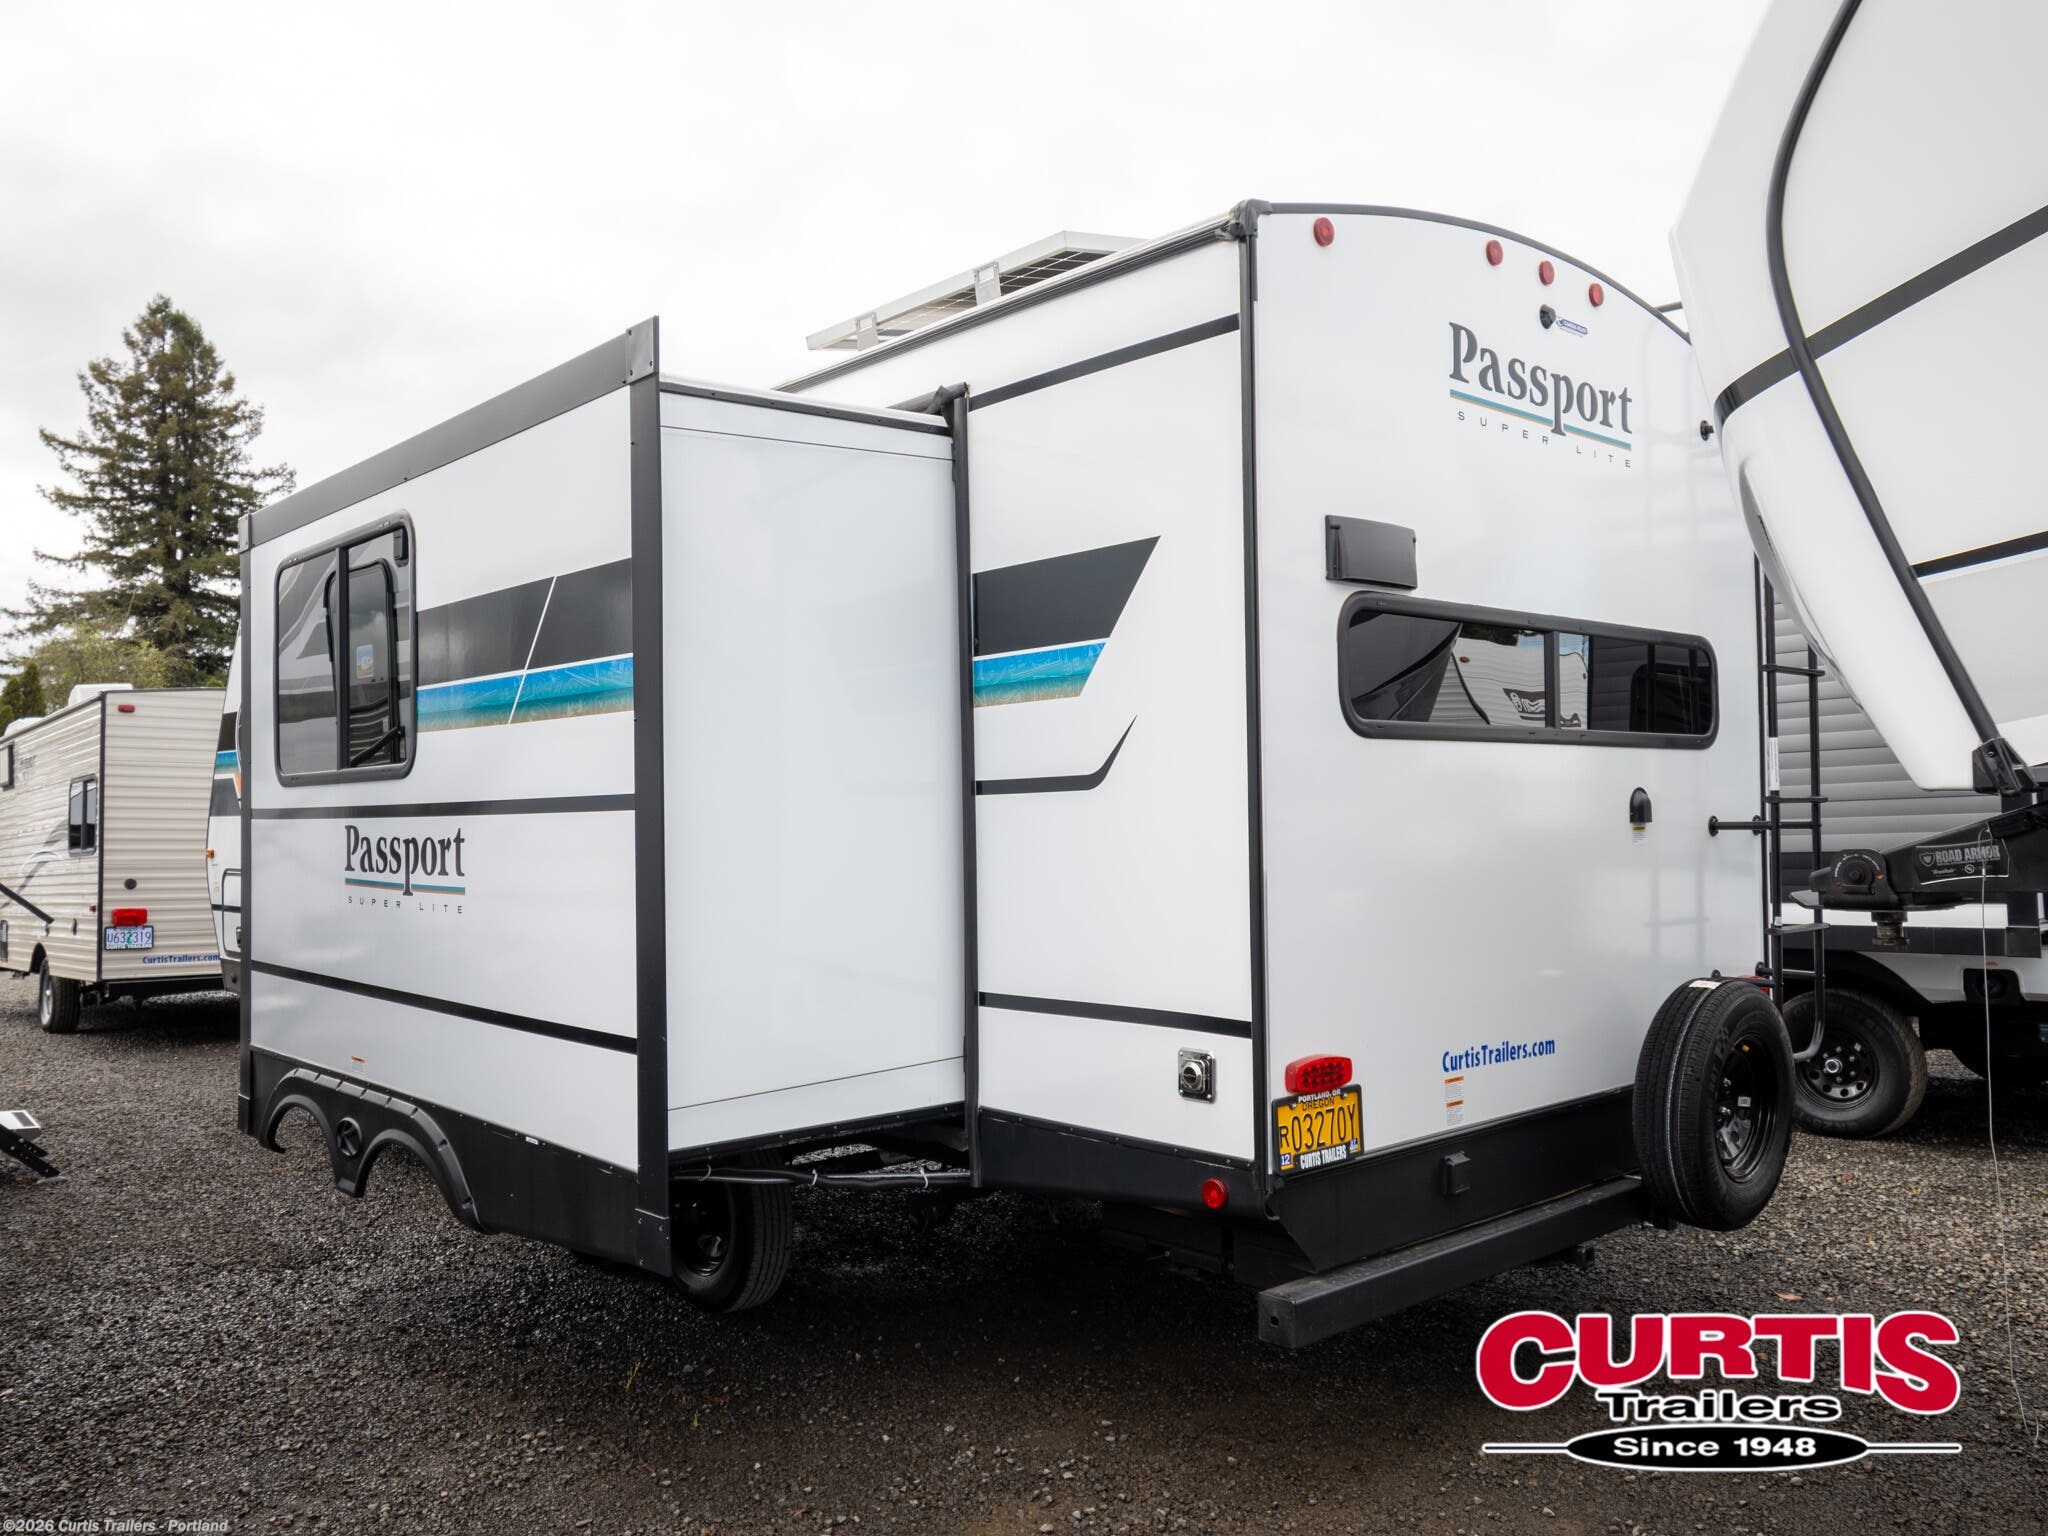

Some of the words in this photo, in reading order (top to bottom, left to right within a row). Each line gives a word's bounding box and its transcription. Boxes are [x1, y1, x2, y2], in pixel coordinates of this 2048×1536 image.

[1449, 322, 1632, 437] Passport
[1458, 411, 1549, 445] SUPER
[1576, 446, 1631, 468] LITE
[345, 825, 465, 896] Passport
[1935, 848, 1962, 863] ROAD
[348, 896, 401, 909] SUPER
[419, 903, 463, 914] LITE
[107, 931, 151, 944] U632319
[1442, 1040, 1555, 1073] CurtisTrailers.com
[1302, 1096, 1335, 1111] OREGON
[1281, 1154, 1290, 1166] 12
[1300, 1151, 1321, 1169] CURTIS
[1321, 1144, 1347, 1165] TRAILERS
